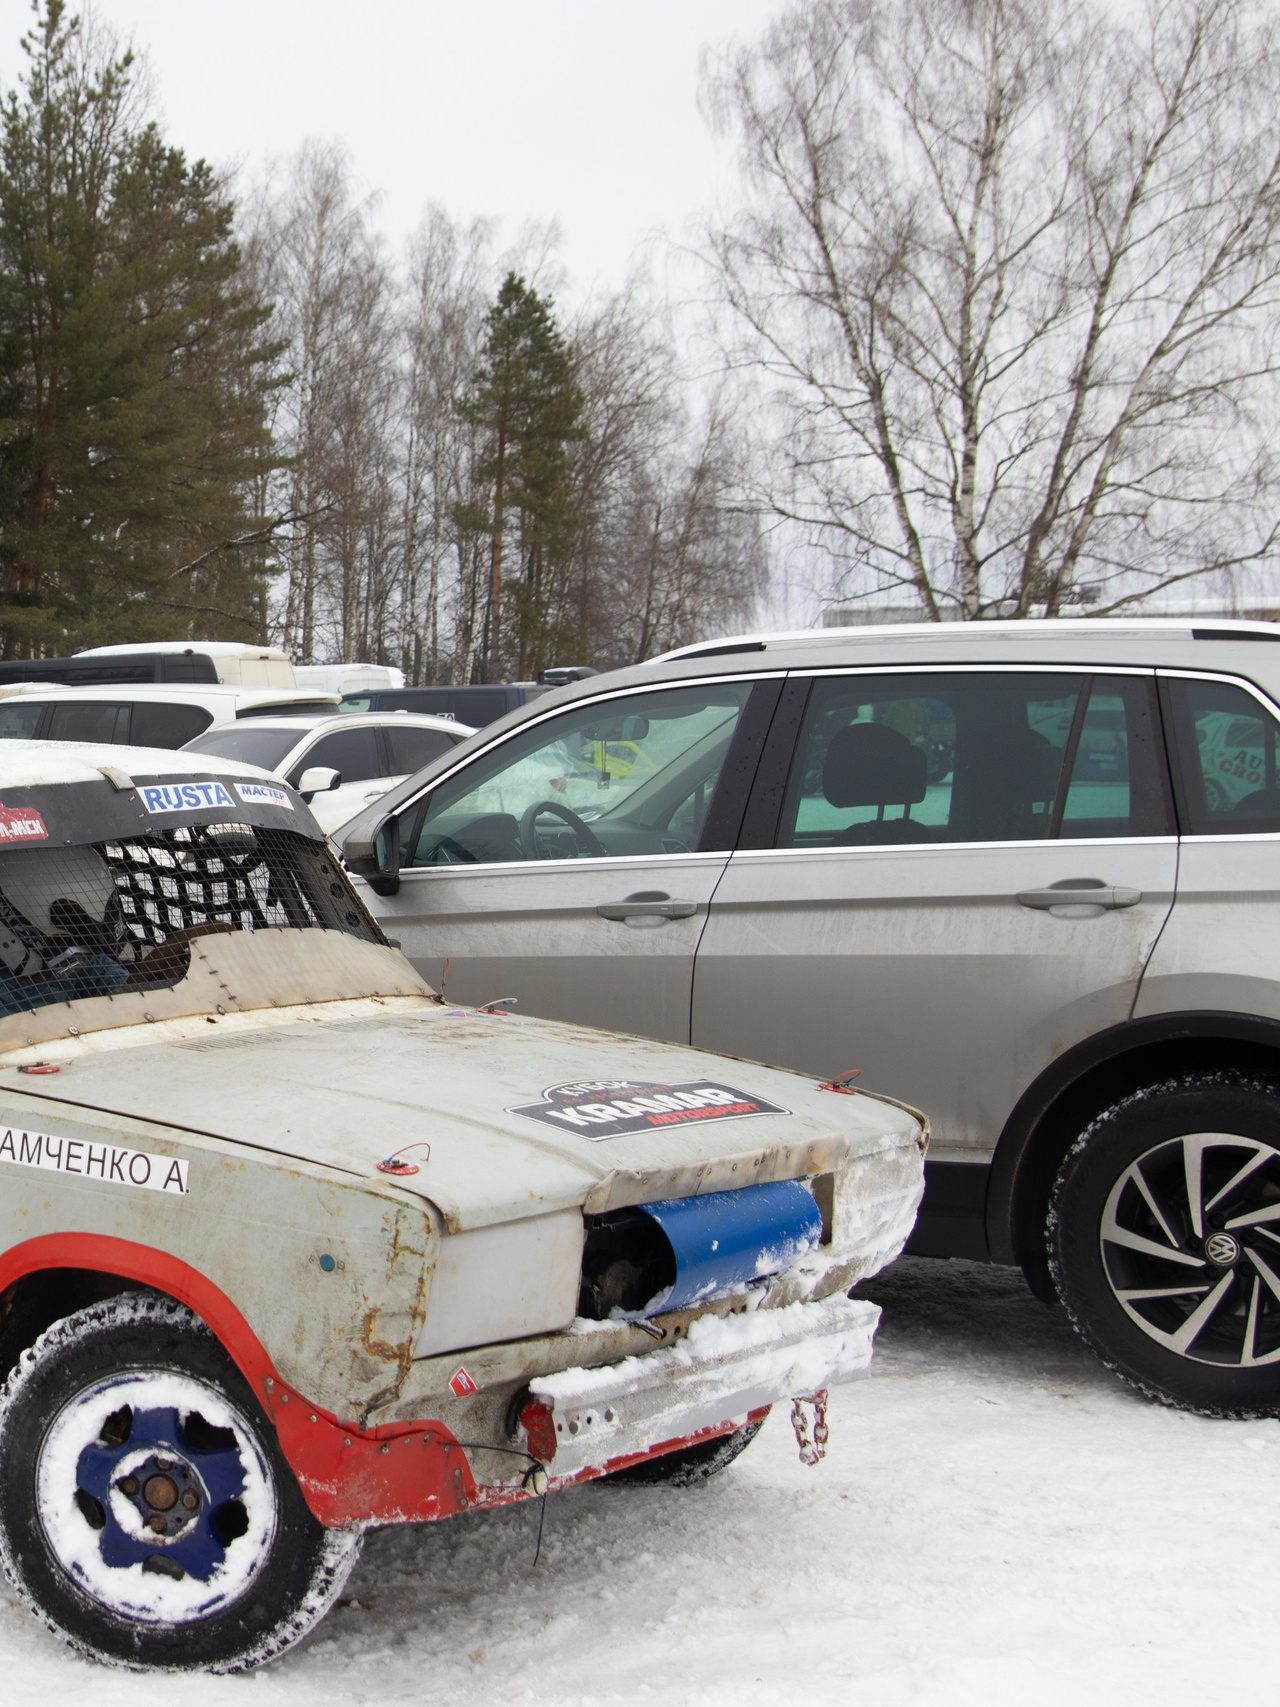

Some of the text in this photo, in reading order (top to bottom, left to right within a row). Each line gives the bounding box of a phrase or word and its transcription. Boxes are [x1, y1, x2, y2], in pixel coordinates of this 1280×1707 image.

[143, 784, 234, 811] RUSTA
[240, 785, 285, 800] МАСТЕР
[556, 1080, 641, 1097] КУБОК
[546, 1088, 748, 1126] KRAMAR
[645, 1103, 761, 1126] MOTORSPORT
